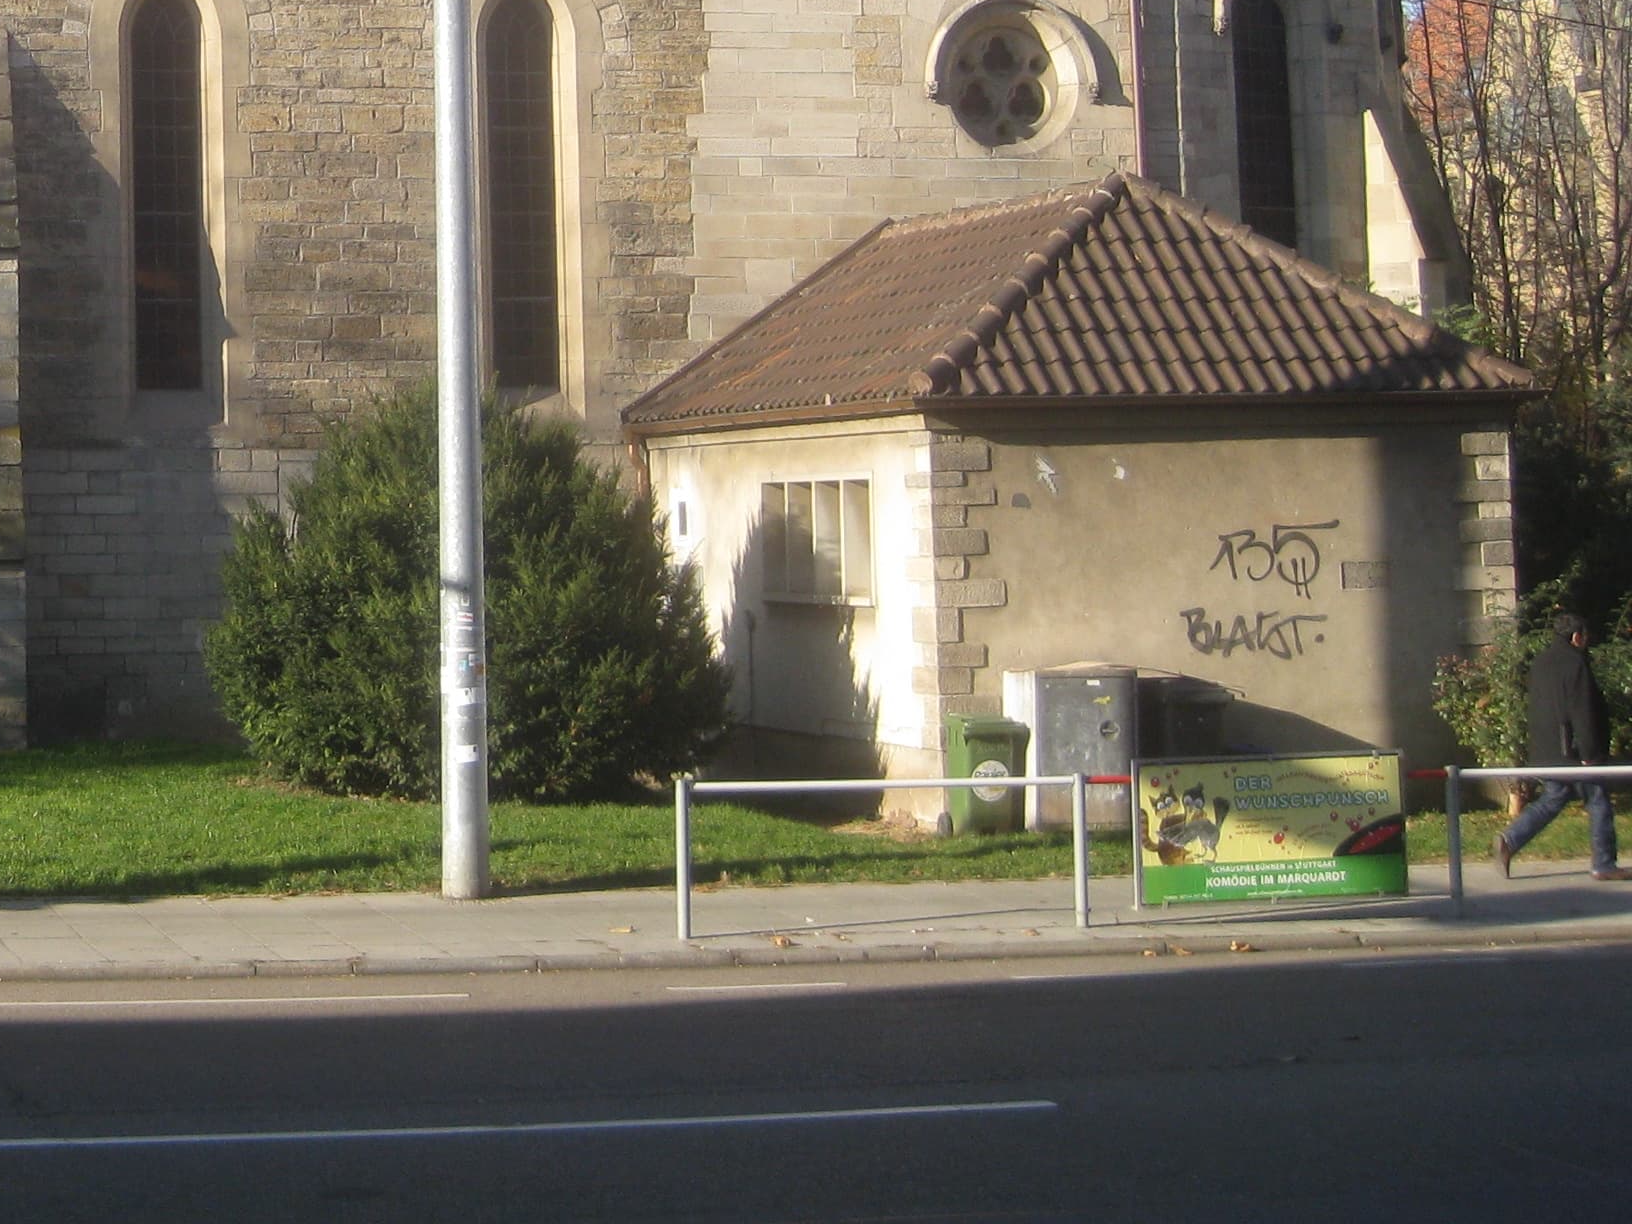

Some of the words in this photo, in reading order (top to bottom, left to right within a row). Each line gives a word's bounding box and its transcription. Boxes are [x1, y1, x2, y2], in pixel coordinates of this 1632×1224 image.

[1234, 776, 1272, 791] DER
[1234, 790, 1389, 810] WUNSCHPUNSCH
[1295, 860, 1337, 871] STUTTGART
[1206, 874, 1257, 888] KOMÖDIE
[1260, 874, 1274, 885] IM
[1277, 870, 1347, 885] MARQUARDT
